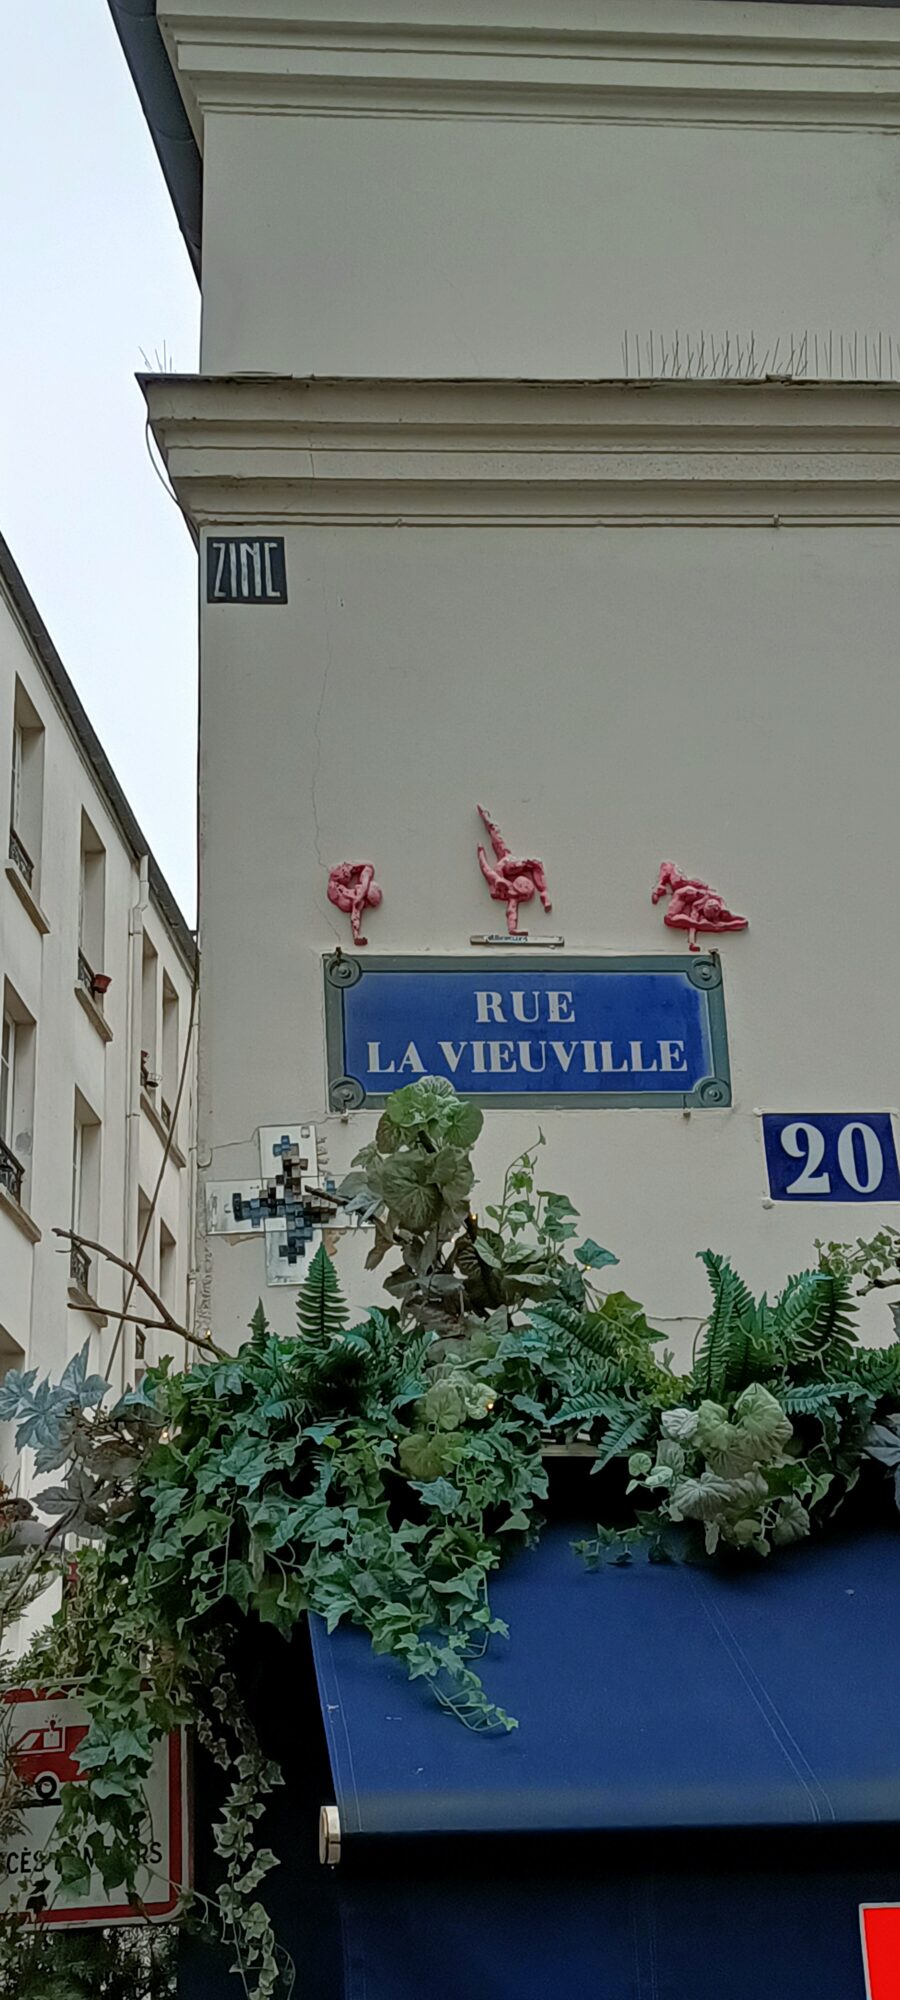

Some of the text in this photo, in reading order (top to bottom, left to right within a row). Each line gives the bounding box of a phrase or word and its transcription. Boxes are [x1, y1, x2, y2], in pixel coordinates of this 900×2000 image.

[213, 542, 280, 598] ZINC
[474, 991, 576, 1024] RUE
[366, 1040, 688, 1074] LA VIEUVILLE
[780, 1121, 884, 1194] 20
[0, 1845, 45, 1875] CÈS
